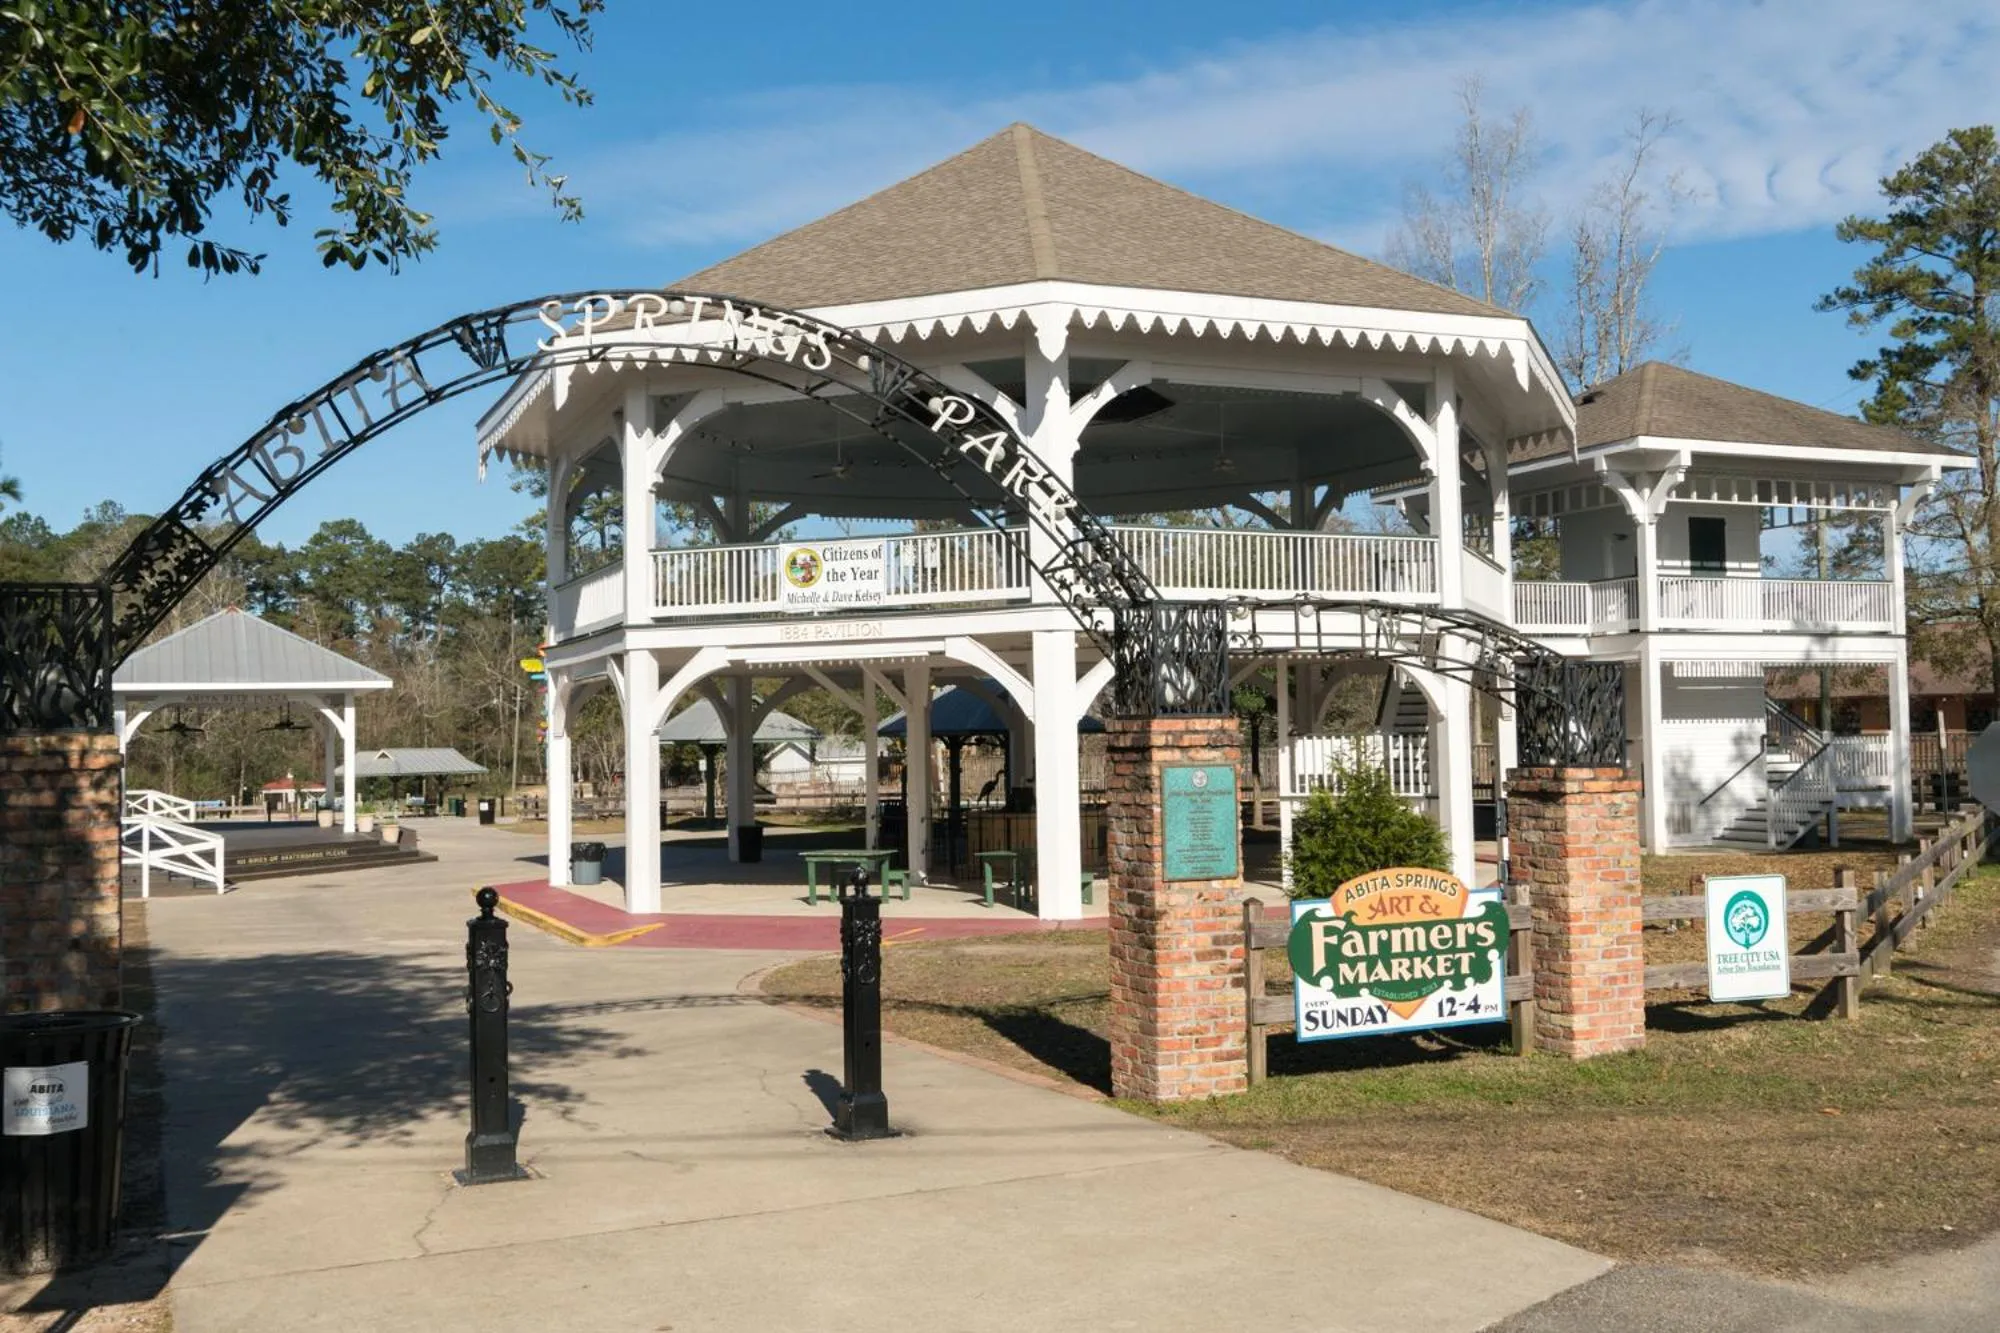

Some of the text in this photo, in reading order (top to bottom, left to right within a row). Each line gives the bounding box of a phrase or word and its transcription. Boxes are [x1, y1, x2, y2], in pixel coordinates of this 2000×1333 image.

[221, 294, 1077, 532] ABITA SPRINGS PARK
[822, 544, 883, 562] Citizens of
[826, 567, 880, 582] the Year
[787, 590, 881, 605] Michelle & Dave Kelsey
[814, 622, 883, 639] PAVILION
[325, 849, 348, 857] PLEASE
[1344, 873, 1458, 904] ABITA SPRINGS
[1367, 893, 1442, 921] ART &
[1309, 919, 1497, 977] Farmers
[1716, 949, 1781, 965] TREE CITY USA
[1338, 951, 1477, 986] MARKET
[1372, 986, 1419, 1000] ESTABLISHED
[1304, 1000, 1329, 1008] EVERY
[1304, 993, 1498, 1032] SUNDAY 12-4 PM
[29, 1083, 64, 1094] ABITA
